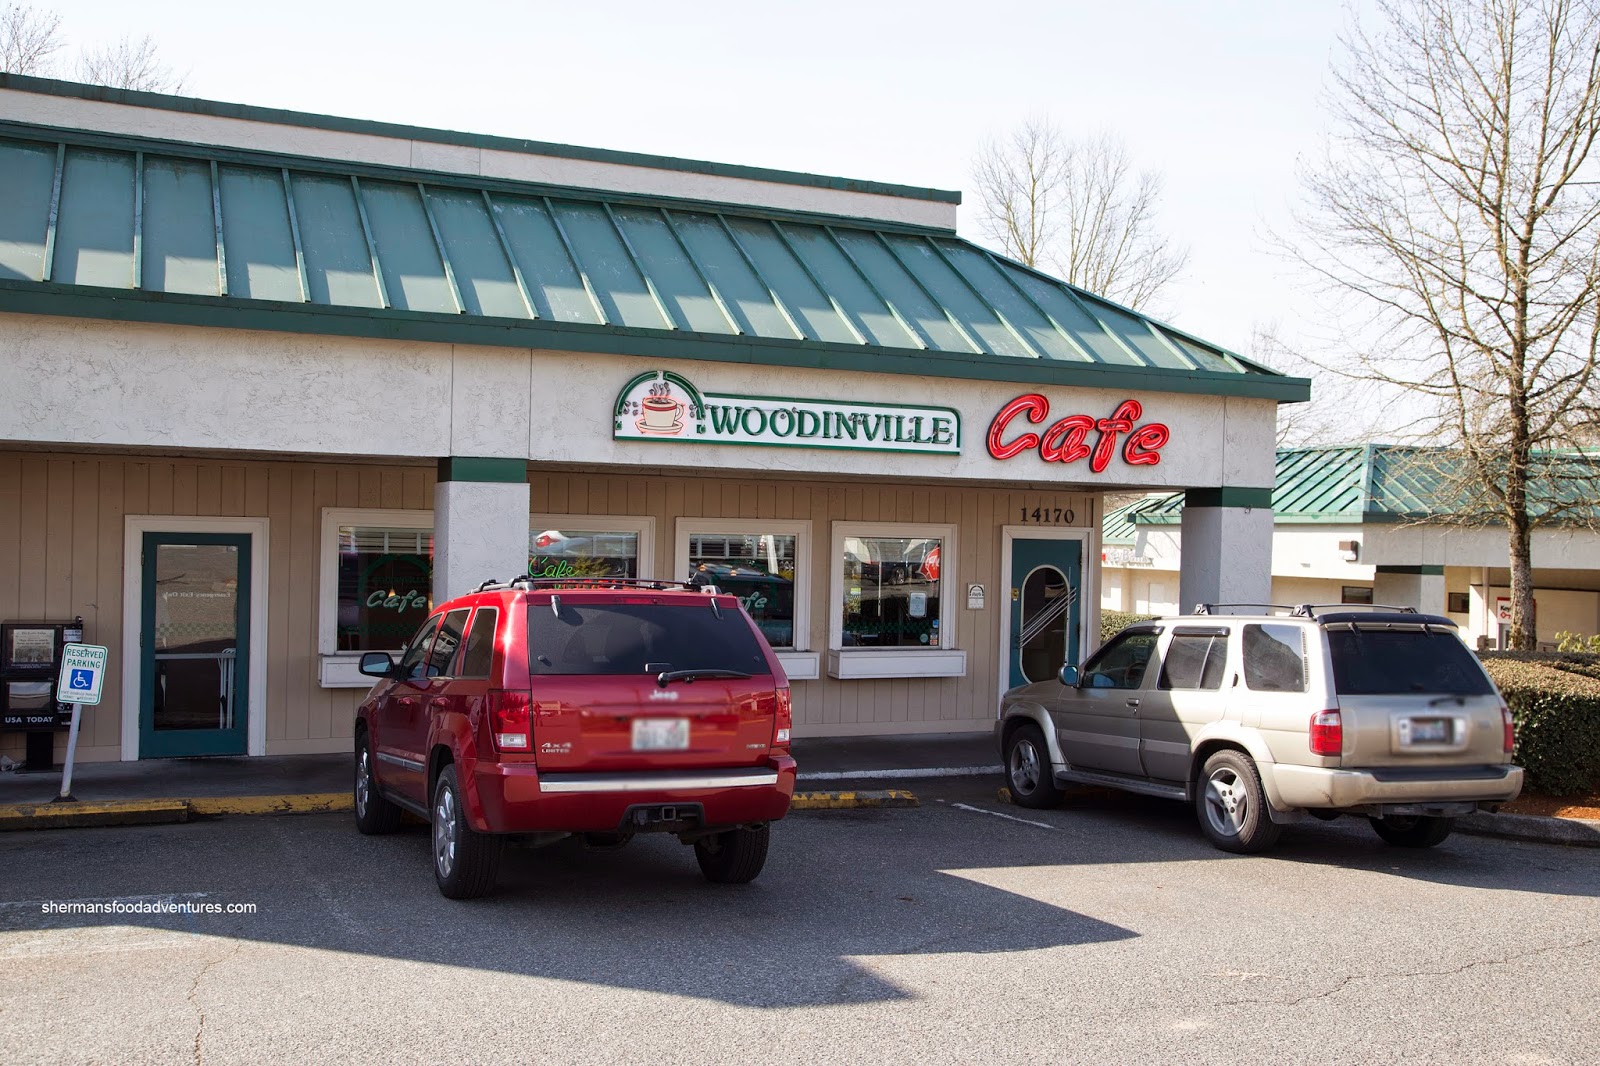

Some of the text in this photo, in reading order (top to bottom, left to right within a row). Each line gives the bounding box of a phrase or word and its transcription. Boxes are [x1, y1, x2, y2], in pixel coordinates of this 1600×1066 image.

[706, 393, 1170, 474] WOODINVILLE Cafe
[1020, 507, 1075, 524] 14170
[529, 555, 580, 578] Cafe
[366, 590, 427, 613] Cafe
[66, 648, 104, 659] RESERVED
[66, 658, 101, 669] PARKING
[5, 716, 22, 724] USA
